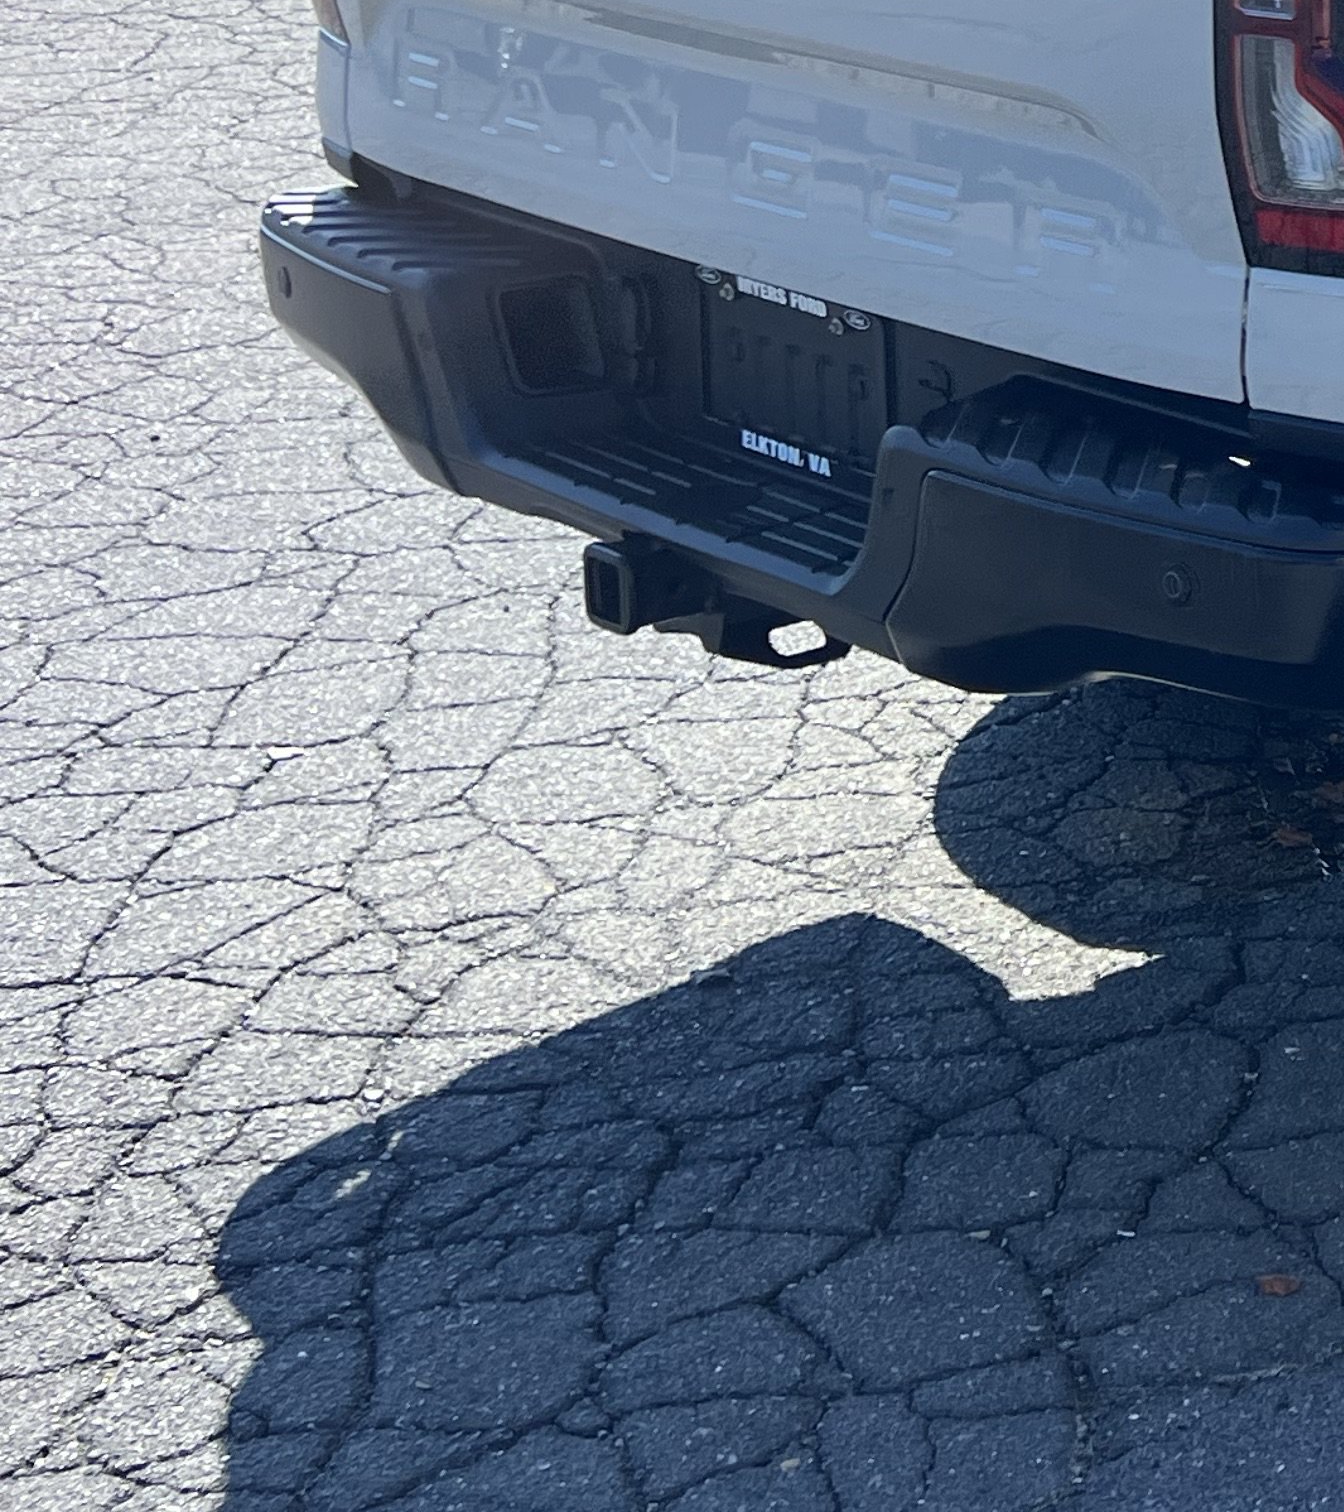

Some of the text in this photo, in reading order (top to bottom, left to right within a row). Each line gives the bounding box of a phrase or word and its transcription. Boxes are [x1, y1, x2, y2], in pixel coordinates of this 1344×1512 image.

[390, 35, 1120, 293] RANGER
[736, 275, 827, 318] MYERS FORD
[741, 428, 832, 477] ELKTON, VA
